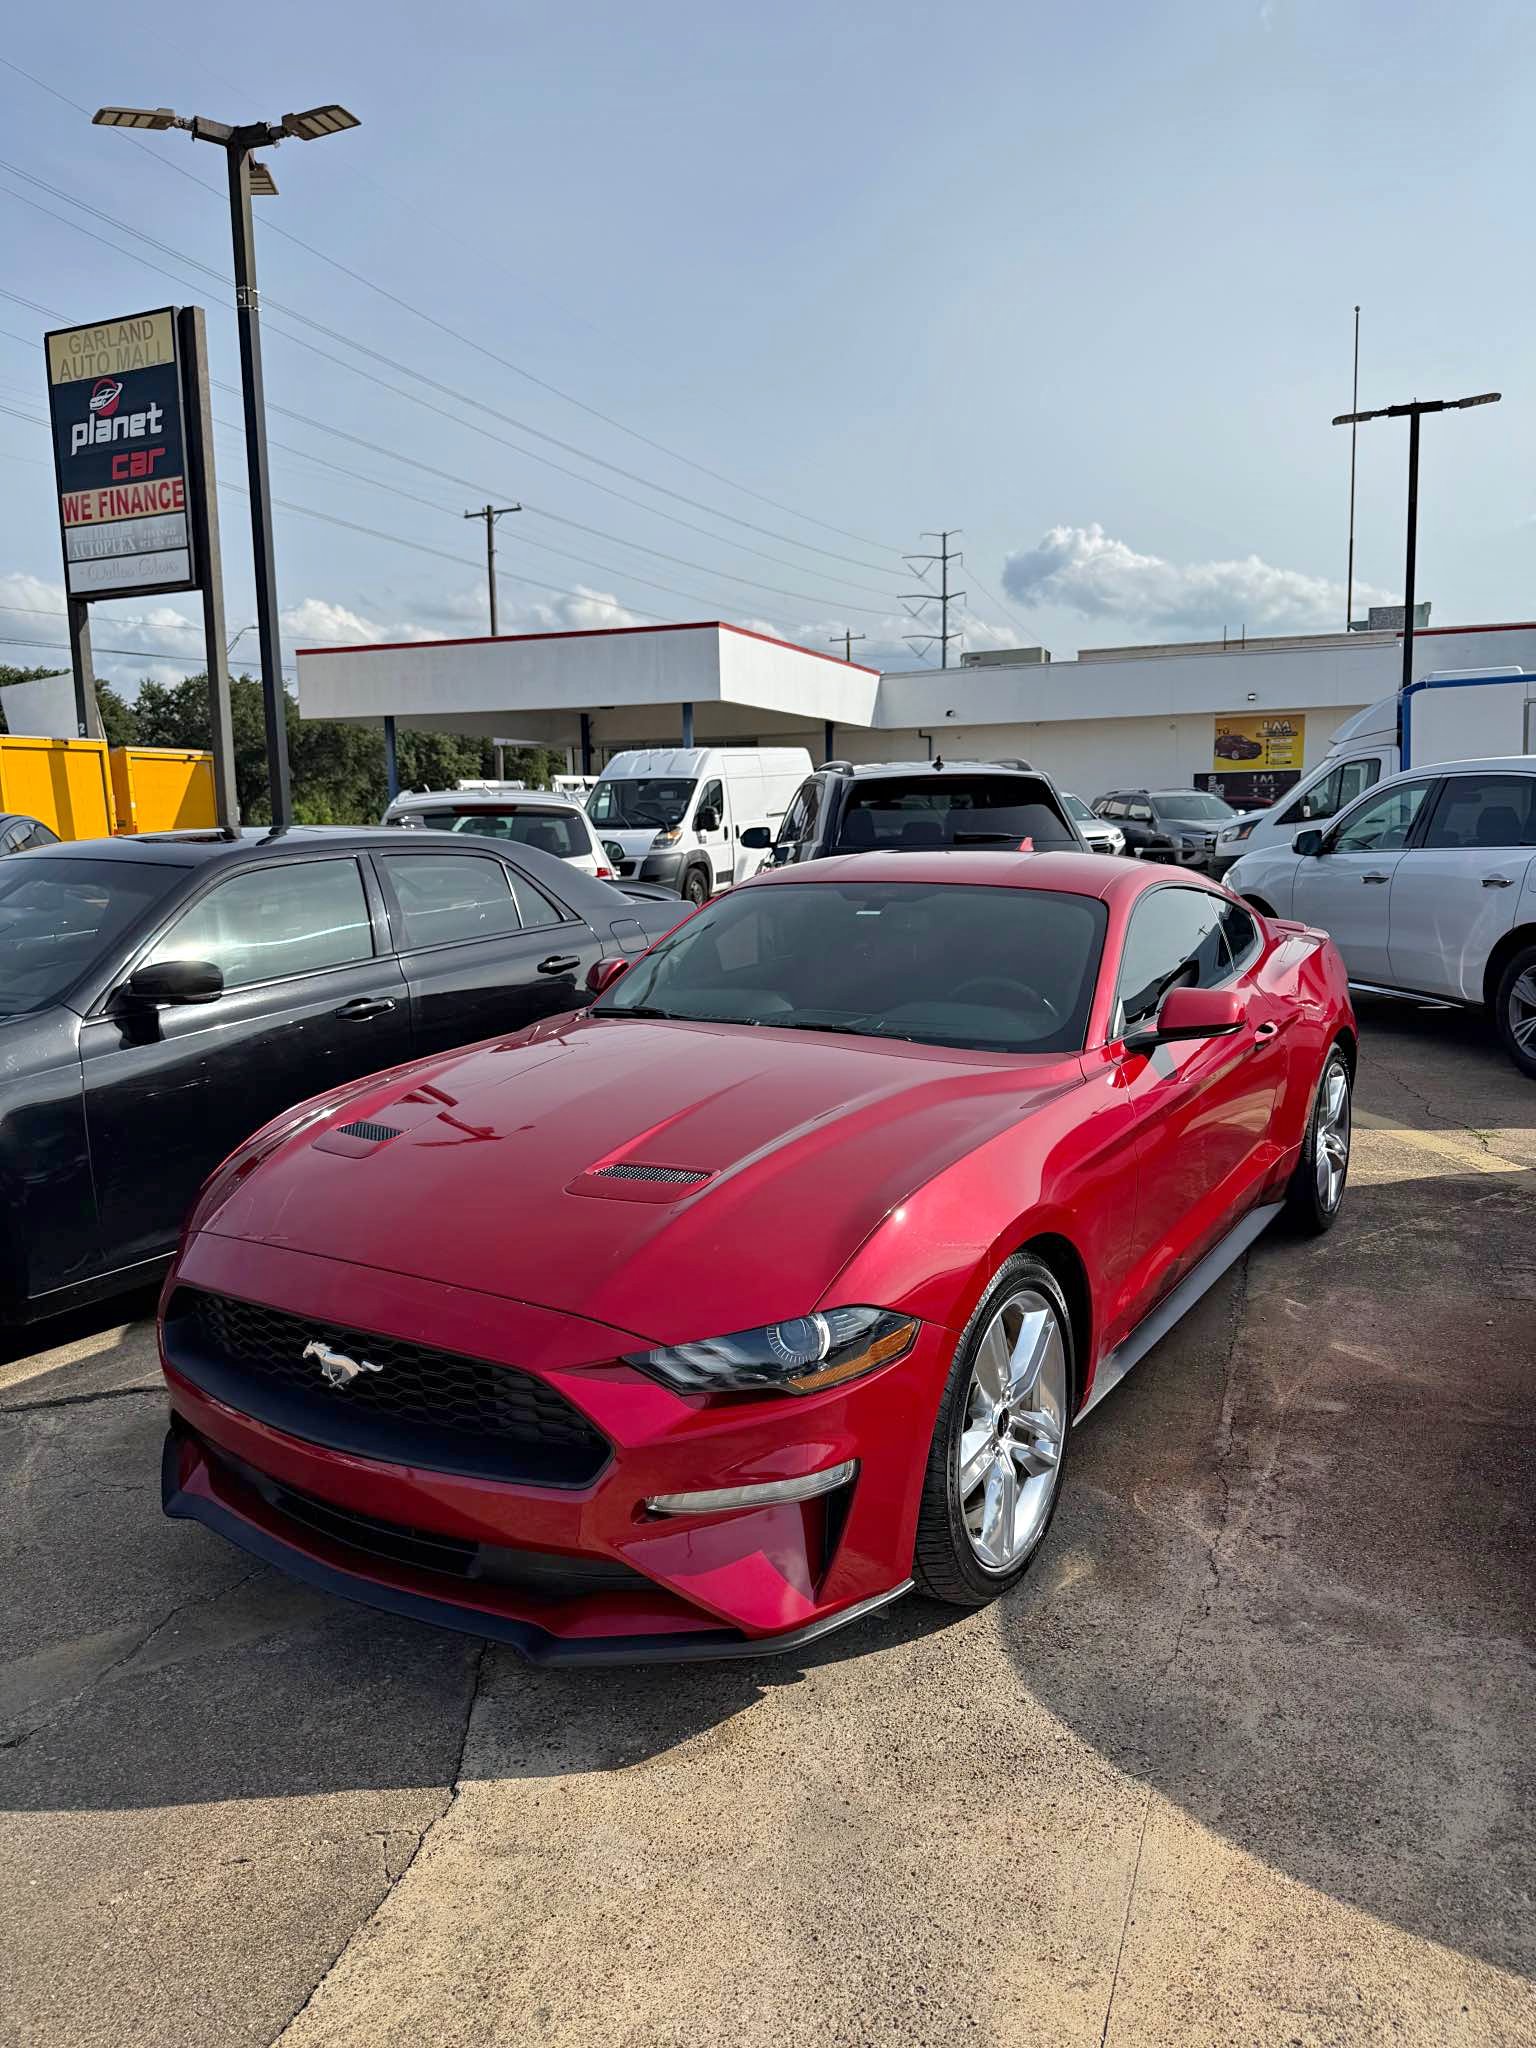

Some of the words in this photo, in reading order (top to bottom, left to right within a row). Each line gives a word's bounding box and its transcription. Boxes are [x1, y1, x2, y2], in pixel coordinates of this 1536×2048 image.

[68, 320, 153, 354] GARLAND
[59, 353, 111, 382] AUTO
[116, 342, 166, 369] MALL
[71, 402, 163, 456] planet
[112, 447, 165, 480] car
[62, 495, 91, 523] WE
[98, 480, 184, 517] FINANCE
[71, 535, 136, 558] AUTOPLEX
